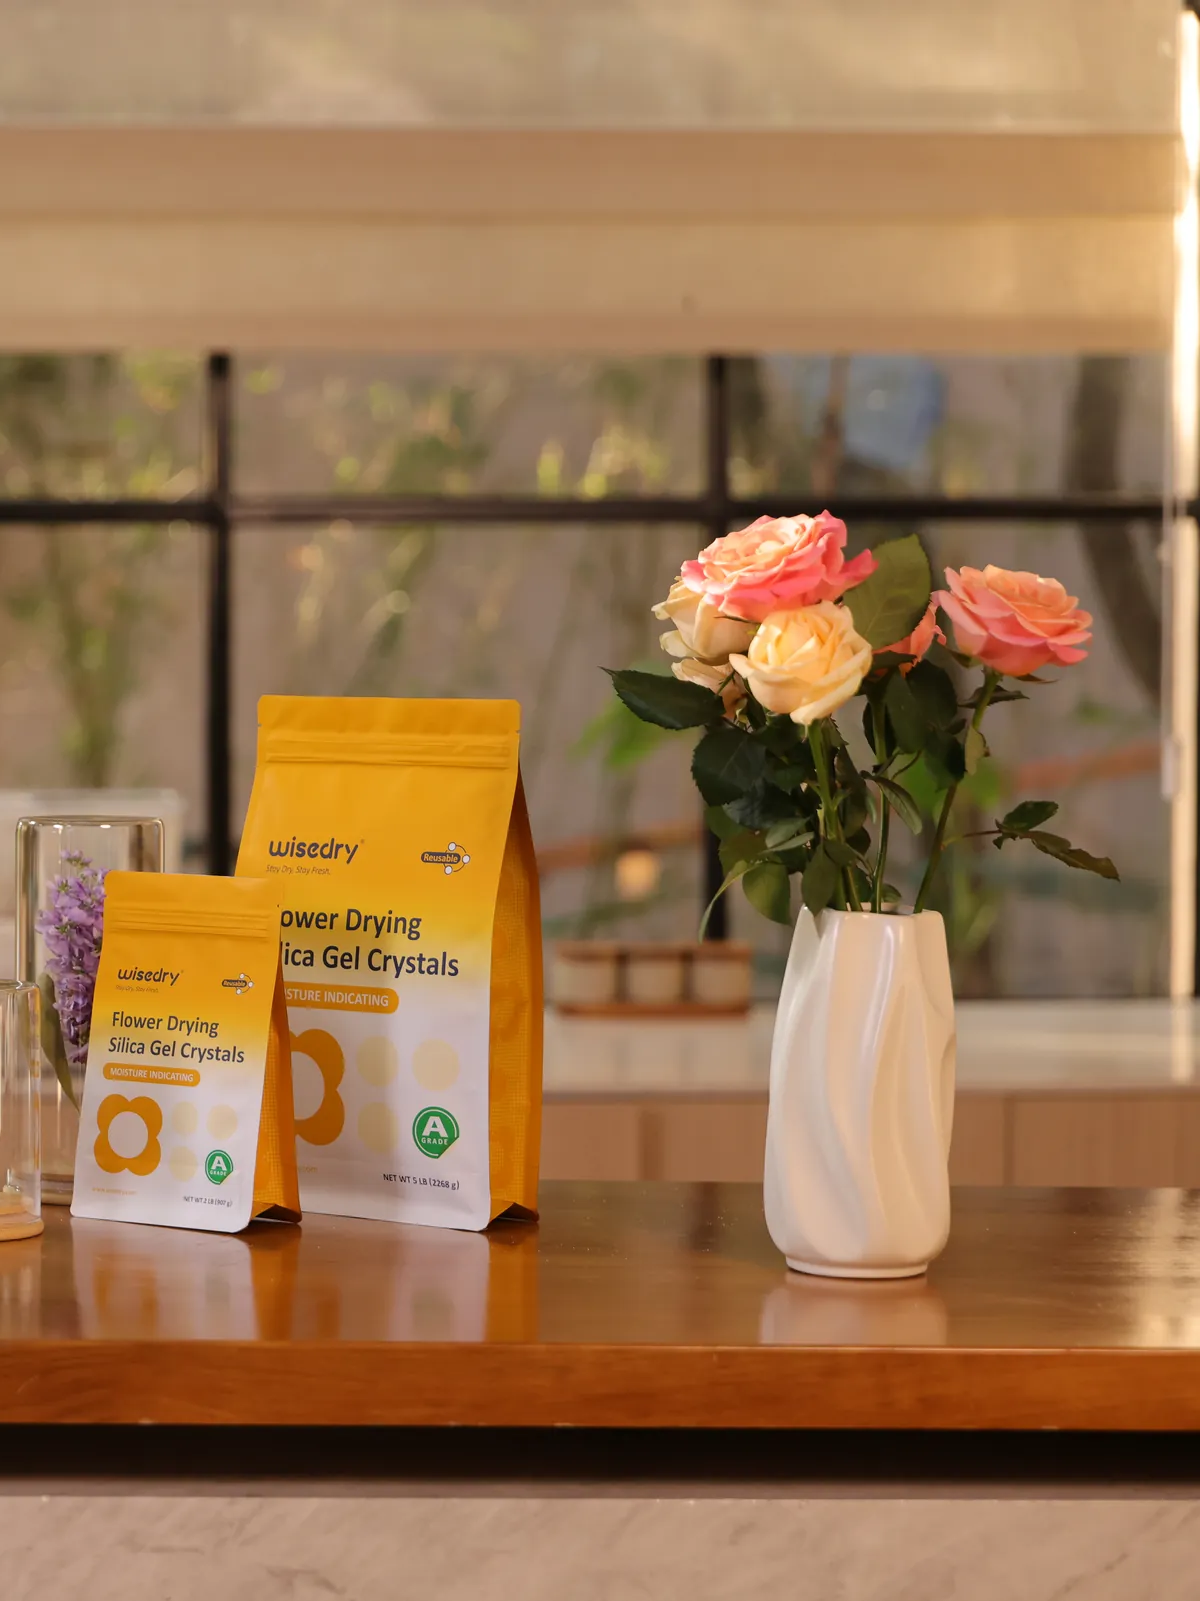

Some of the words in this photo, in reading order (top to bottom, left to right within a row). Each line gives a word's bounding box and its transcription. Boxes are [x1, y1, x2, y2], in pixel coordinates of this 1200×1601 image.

[269, 836, 359, 864] wisedry
[423, 853, 458, 863] Reusable
[280, 910, 339, 930] ower
[345, 908, 422, 940] Drying
[322, 945, 360, 970] Gel
[367, 948, 459, 979] Crystals
[117, 967, 180, 986] wisedry
[324, 991, 389, 1007] INDICATING
[112, 1011, 163, 1030] Flower
[167, 1015, 219, 1038] Drying
[108, 1037, 145, 1055] Silica
[150, 1040, 176, 1057] Gel
[180, 1042, 245, 1063] Crystals
[110, 1067, 148, 1078] MOISTURE
[149, 1070, 194, 1082] INDICATING
[422, 1116, 449, 1138] A
[421, 1137, 448, 1145] GRADE
[211, 1156, 227, 1170] A
[383, 1173, 397, 1182] NET
[398, 1175, 411, 1183] WT
[419, 1178, 428, 1186] LB
[429, 1178, 450, 1188] (2268
[451, 1180, 460, 1190] g)
